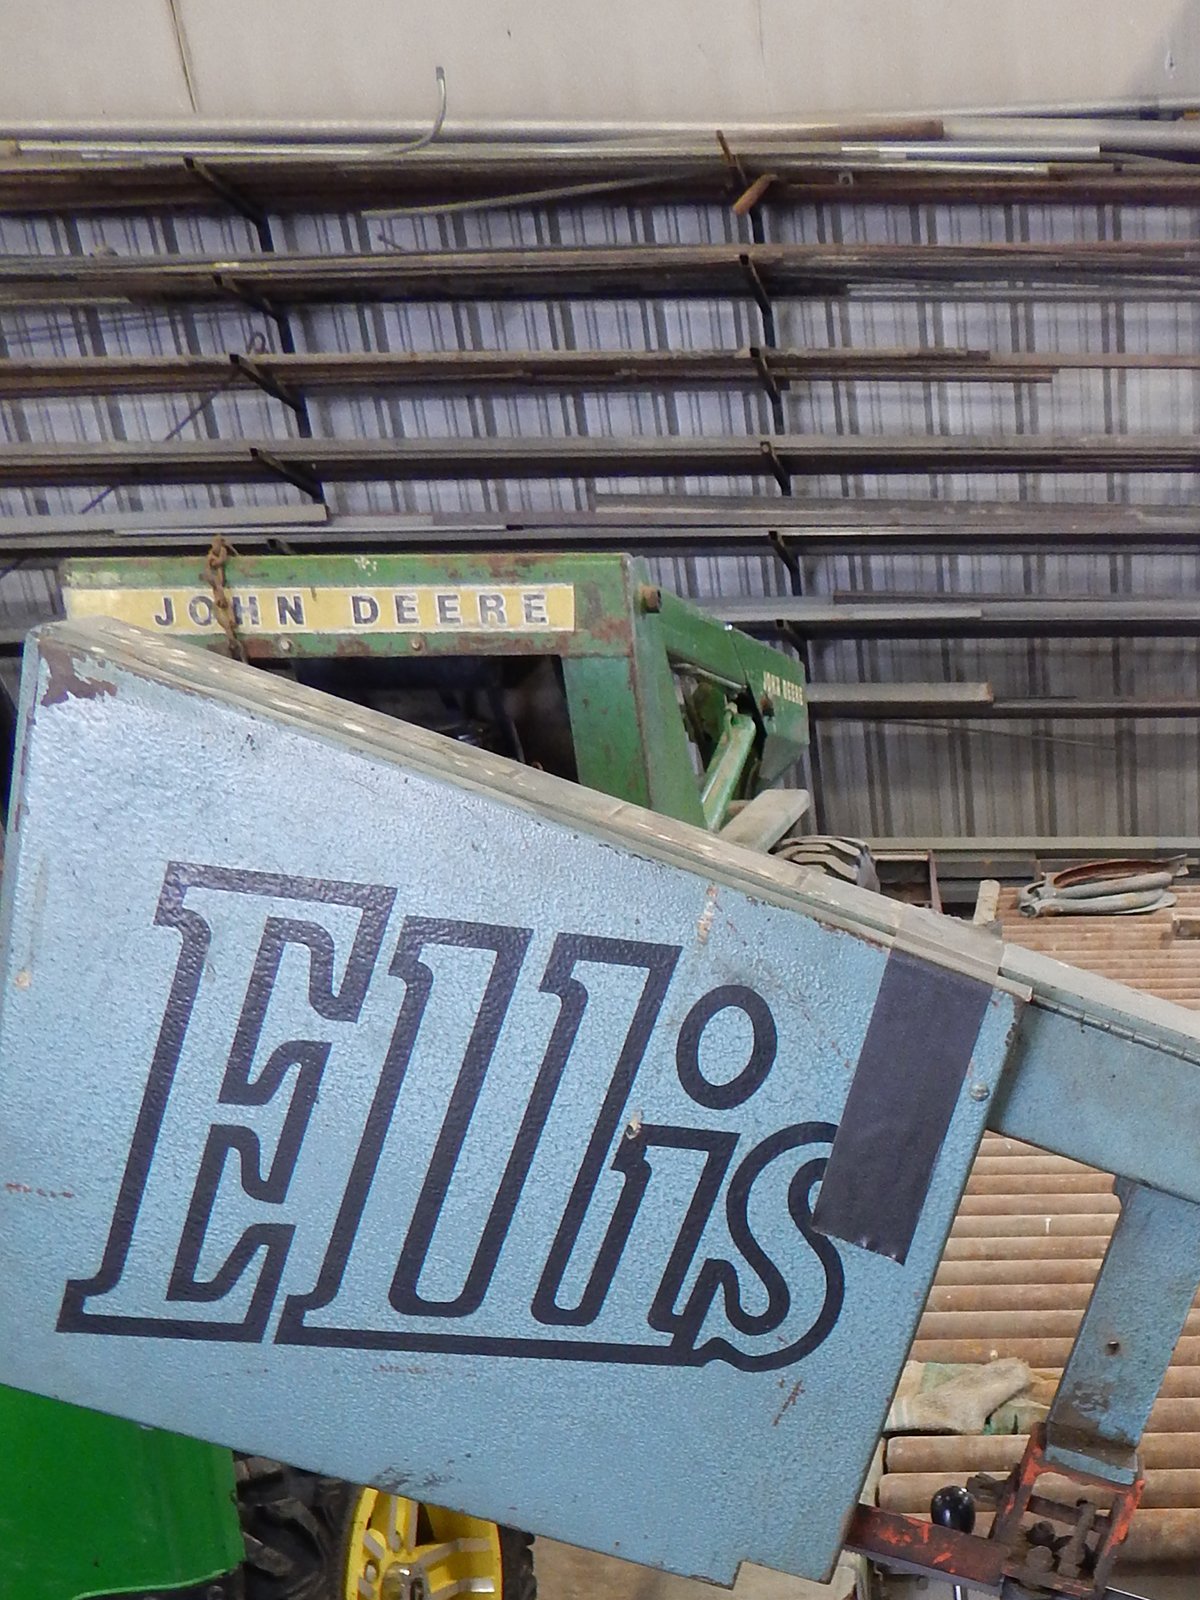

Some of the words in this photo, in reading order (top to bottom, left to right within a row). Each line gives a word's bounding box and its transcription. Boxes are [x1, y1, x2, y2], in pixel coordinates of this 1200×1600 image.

[155, 594, 304, 627] JOHN
[351, 593, 549, 625] DEERE
[56, 860, 846, 1373] Ellis
